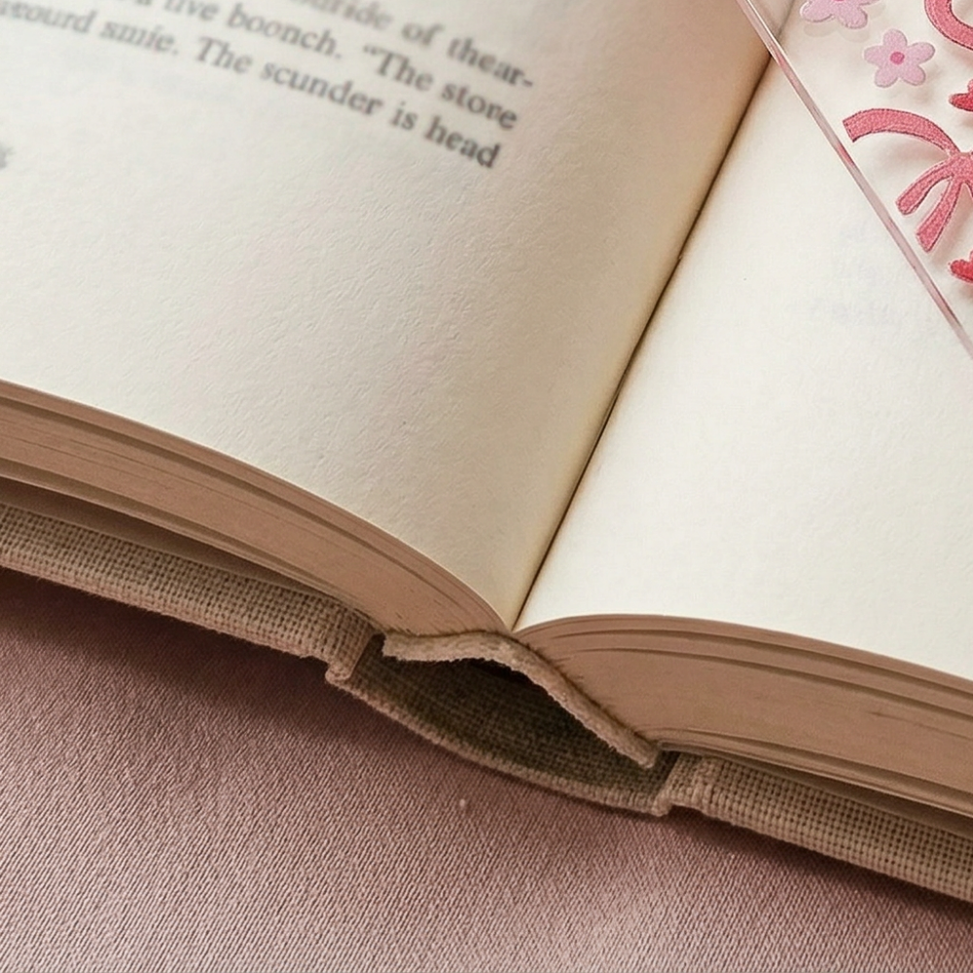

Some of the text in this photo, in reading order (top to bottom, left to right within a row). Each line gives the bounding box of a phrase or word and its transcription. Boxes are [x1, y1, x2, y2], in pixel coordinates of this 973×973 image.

[399, 21, 446, 50] of
[195, 34, 254, 76] The
[260, 60, 385, 117] scunder
[389, 99, 419, 131] is
[423, 113, 503, 170] head
[438, 81, 519, 132] store
